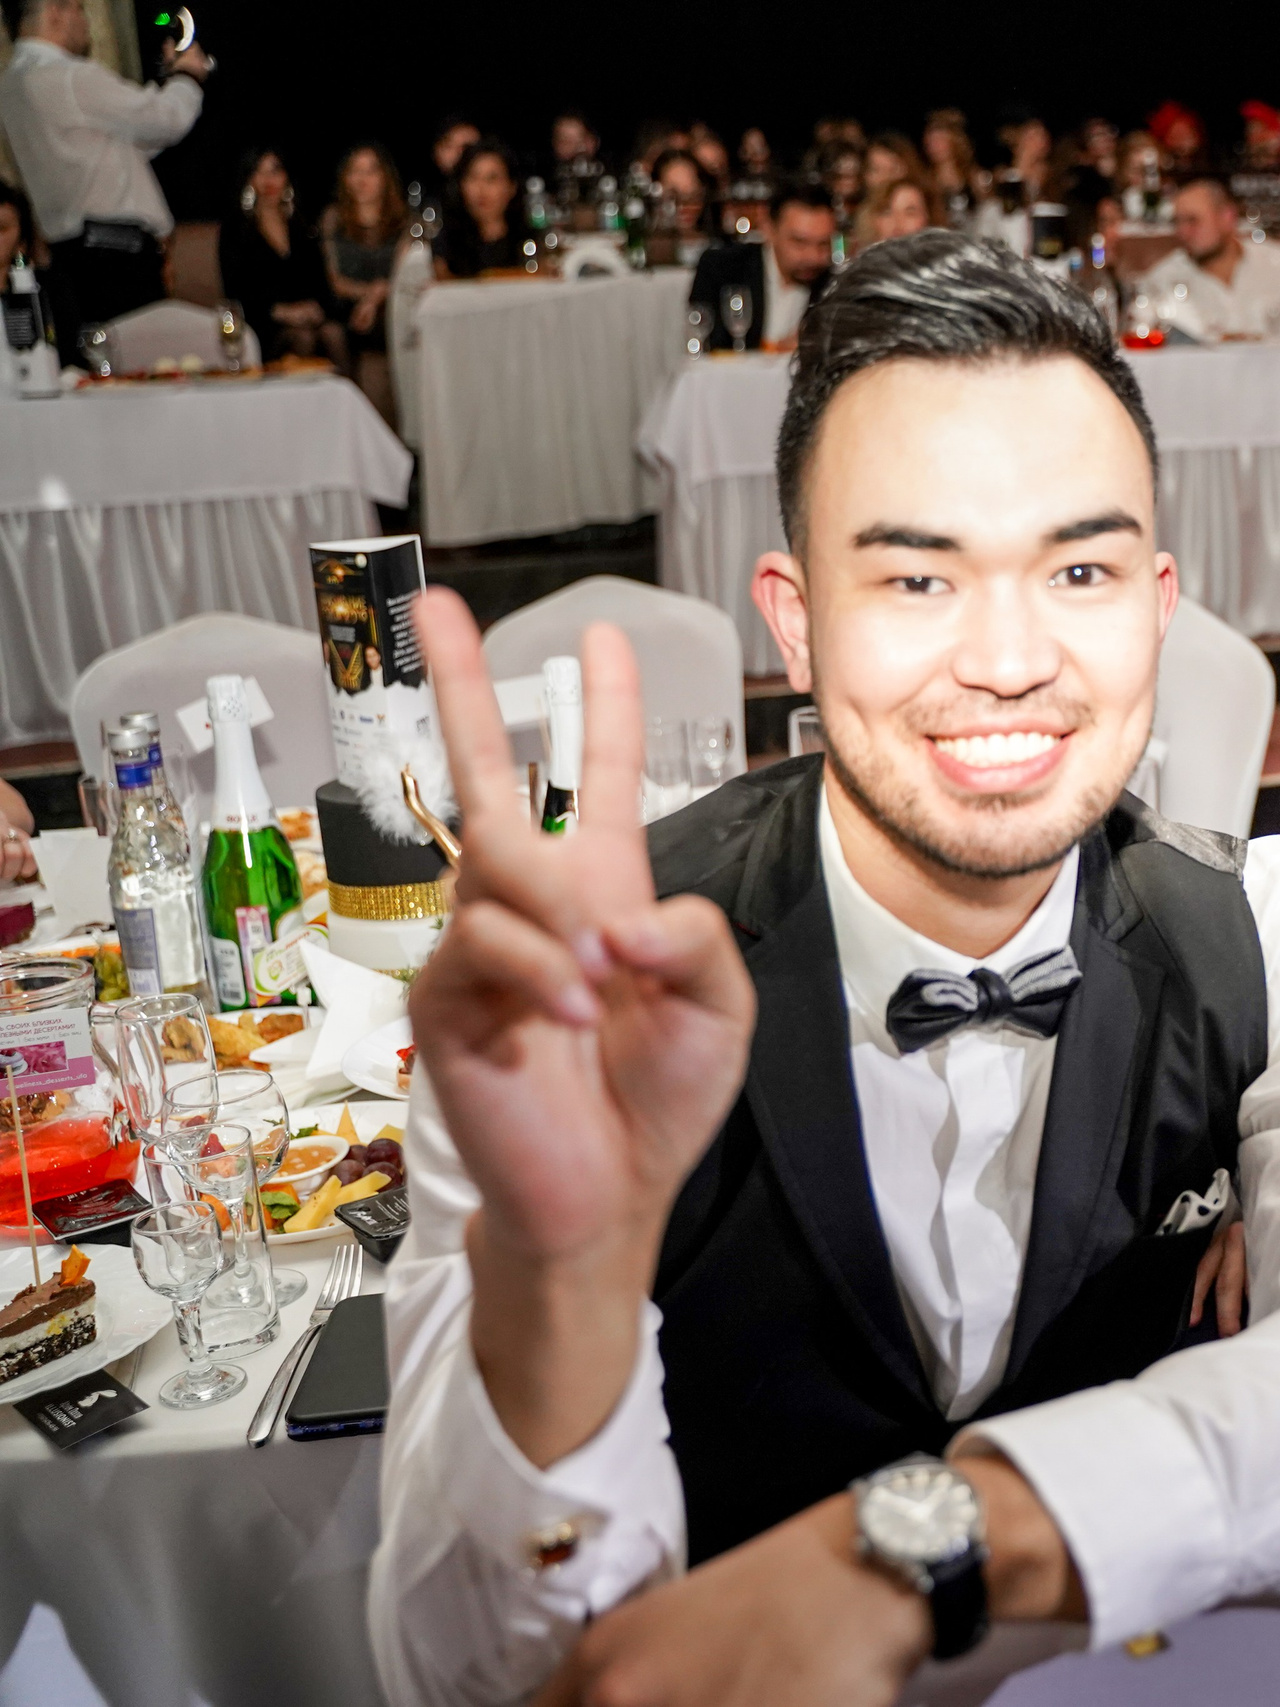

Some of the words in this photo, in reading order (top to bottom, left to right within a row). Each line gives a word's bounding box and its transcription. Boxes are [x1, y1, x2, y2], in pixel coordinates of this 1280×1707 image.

[6, 1022, 30, 1031] СВОИХ
[32, 1018, 63, 1027] БЛИЗКИХ
[44, 1402, 77, 1429] ILLUSIONIST
